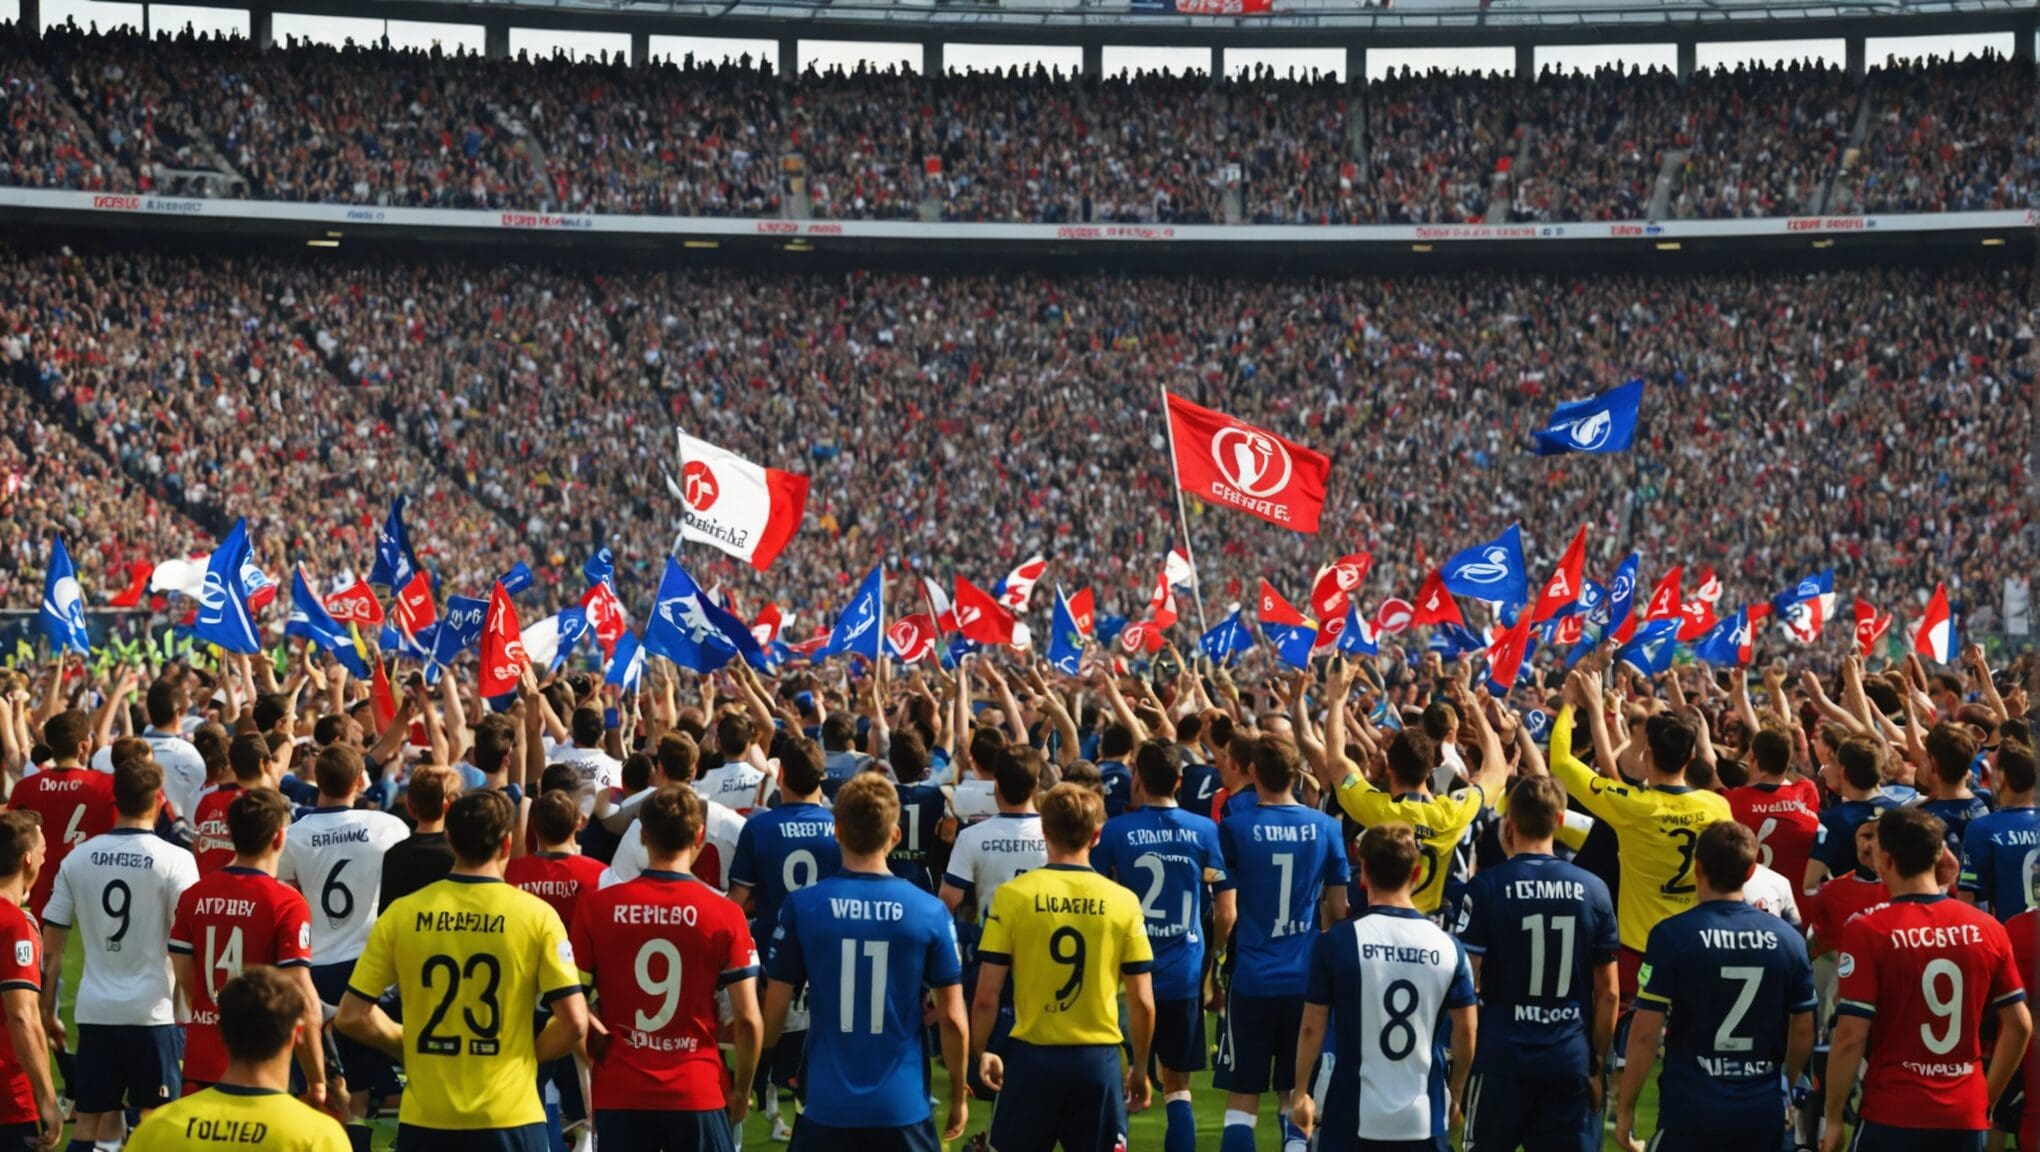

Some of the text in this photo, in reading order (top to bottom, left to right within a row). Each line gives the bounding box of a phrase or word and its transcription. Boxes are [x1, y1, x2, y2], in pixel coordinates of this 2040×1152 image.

[102, 879, 132, 943] 9
[320, 858, 356, 919] 6
[634, 938, 683, 1033] 9
[840, 938, 889, 1034] 11
[1049, 925, 1086, 1012] 9
[1521, 912, 1577, 998] 11
[417, 952, 501, 1056] 23
[1379, 979, 1419, 1062] 8
[1920, 958, 1964, 1055] 9
